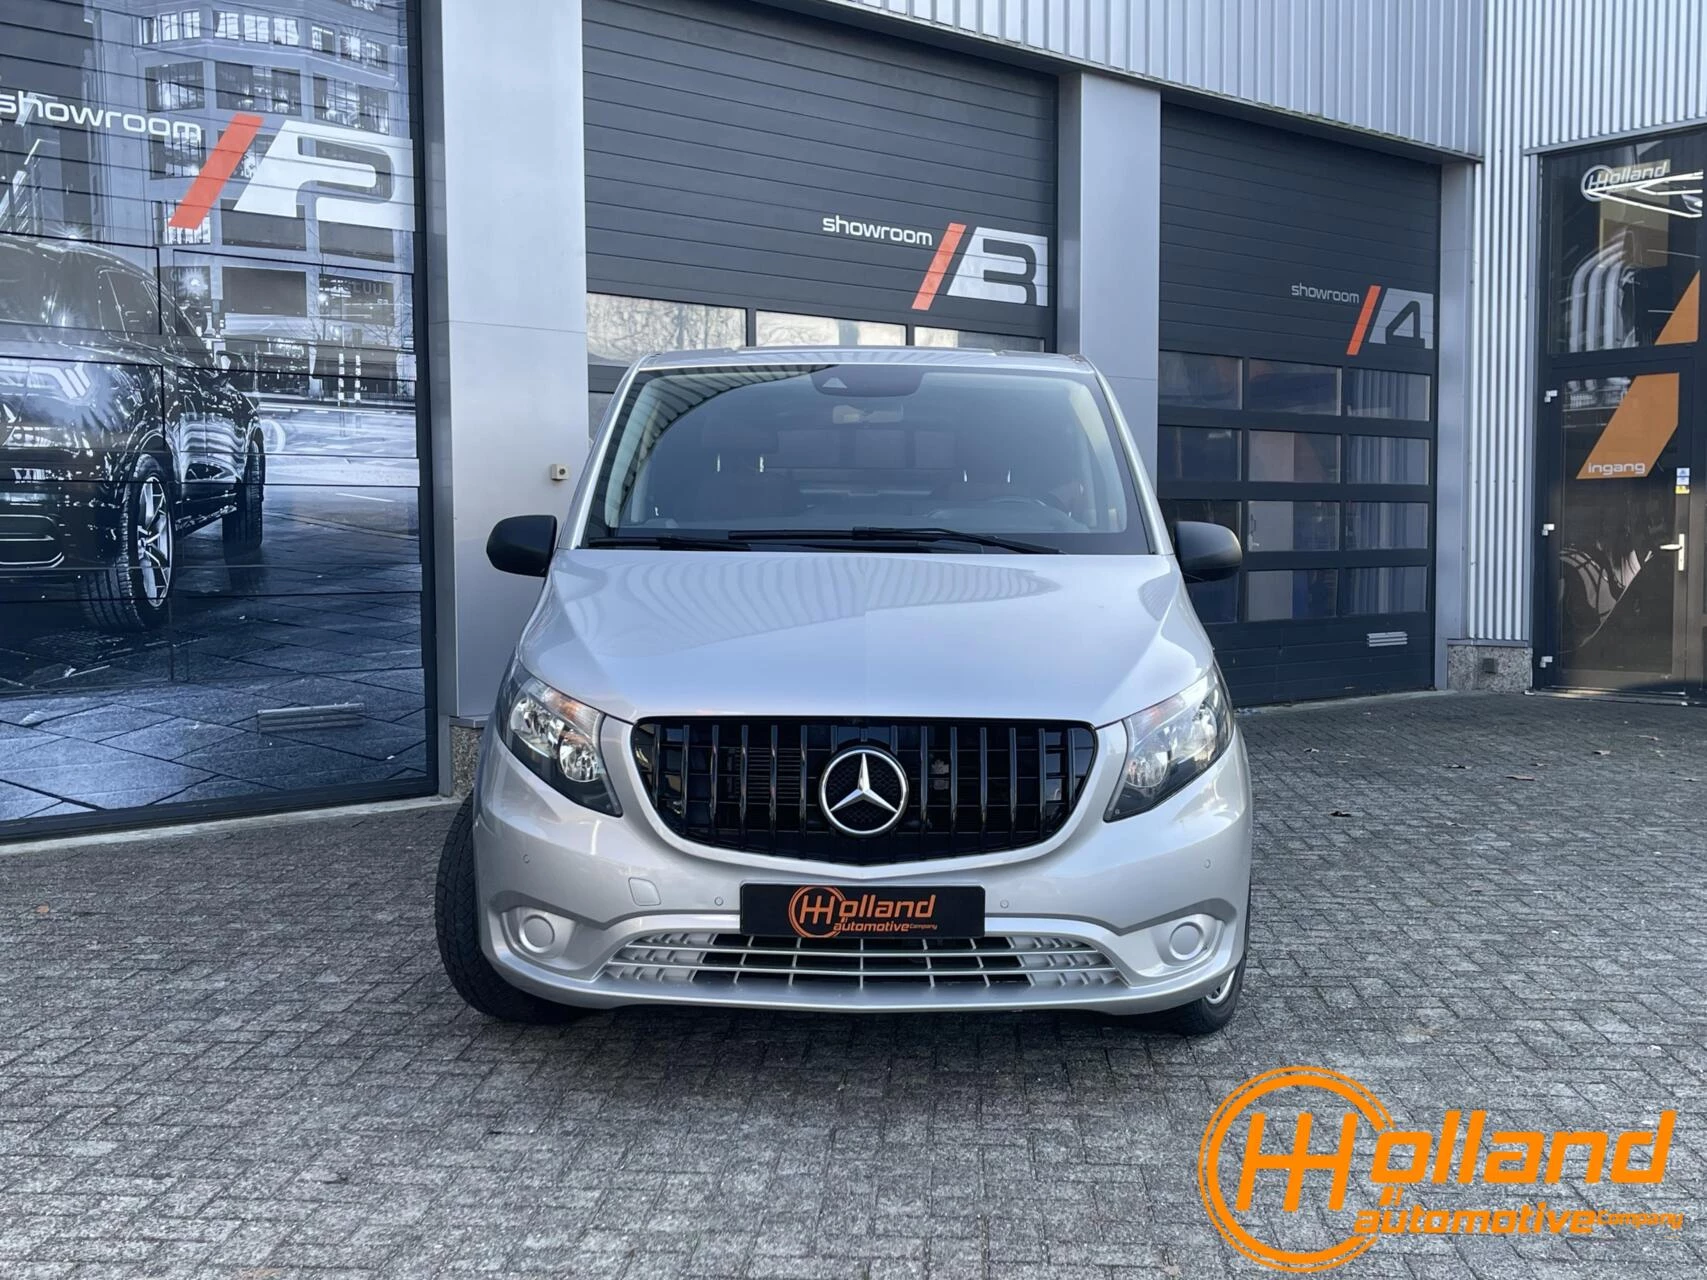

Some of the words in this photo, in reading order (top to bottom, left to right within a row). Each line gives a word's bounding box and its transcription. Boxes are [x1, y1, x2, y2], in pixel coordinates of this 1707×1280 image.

[0, 90, 202, 144] showroom
[822, 215, 933, 246] showroom
[1291, 282, 1360, 304] showroom
[1587, 462, 1646, 475] ingang
[833, 920, 910, 932] automotive
